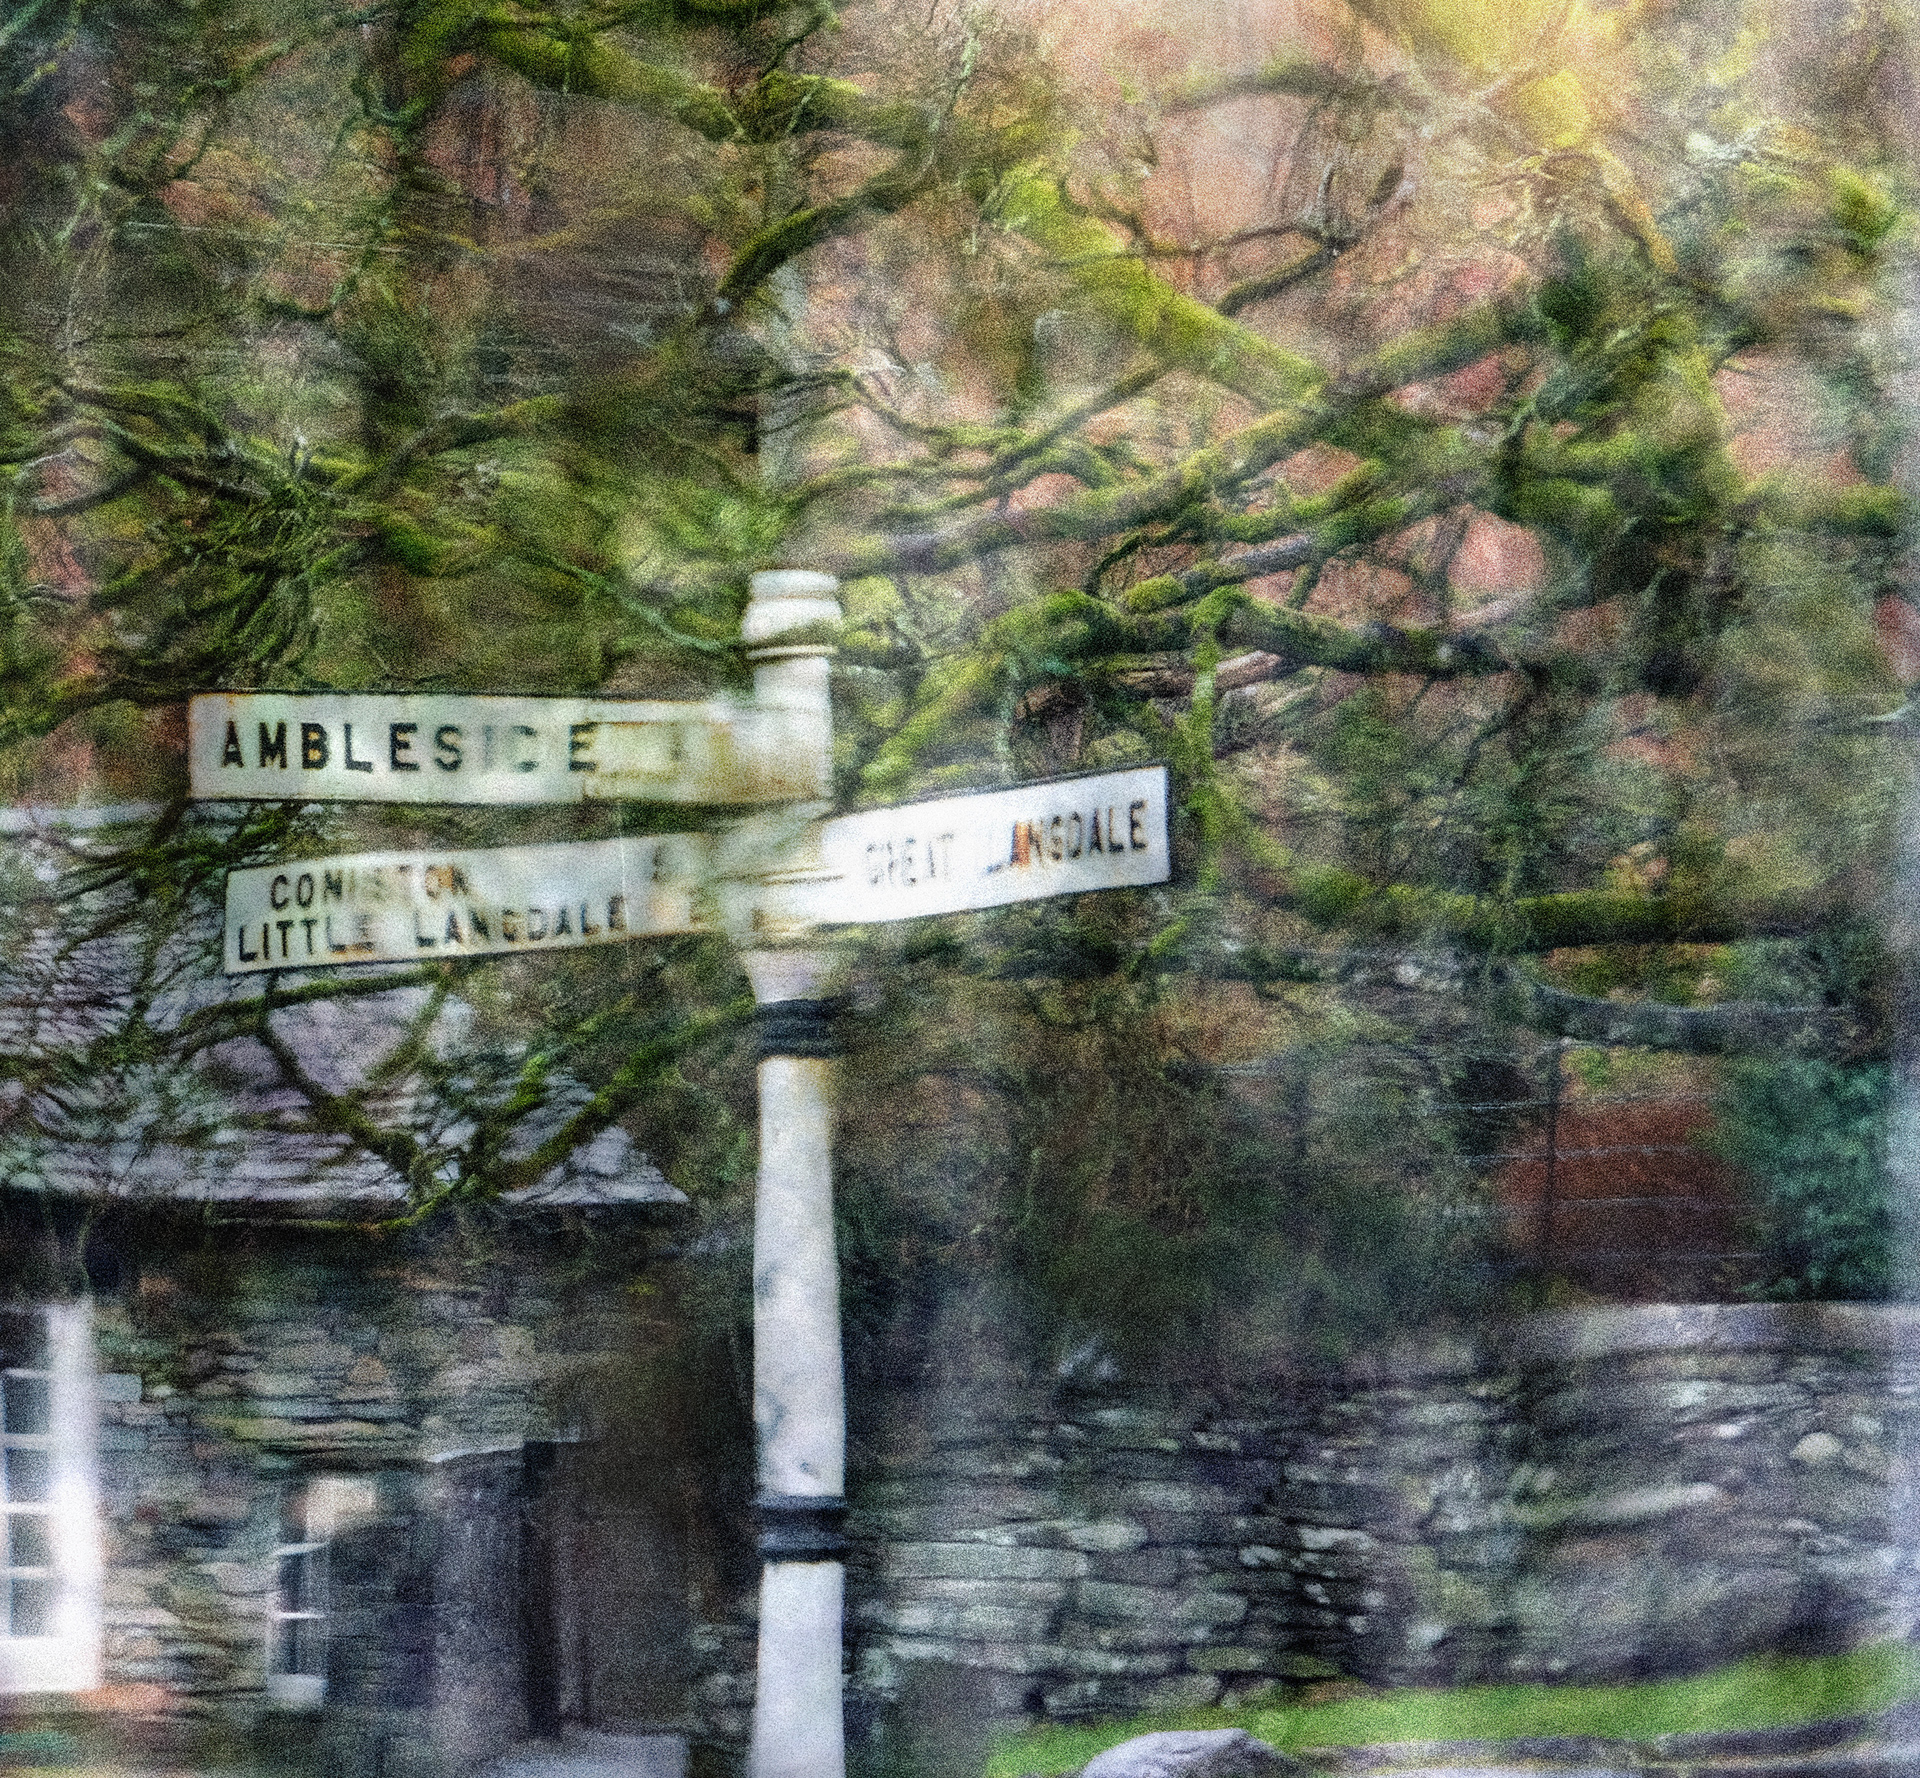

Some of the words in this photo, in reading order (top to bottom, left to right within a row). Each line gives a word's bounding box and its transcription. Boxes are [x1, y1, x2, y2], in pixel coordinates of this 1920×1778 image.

[221, 721, 599, 773] AMBLESIDE
[985, 799, 1148, 875] NGDALE
[238, 912, 375, 964] LITTLE
